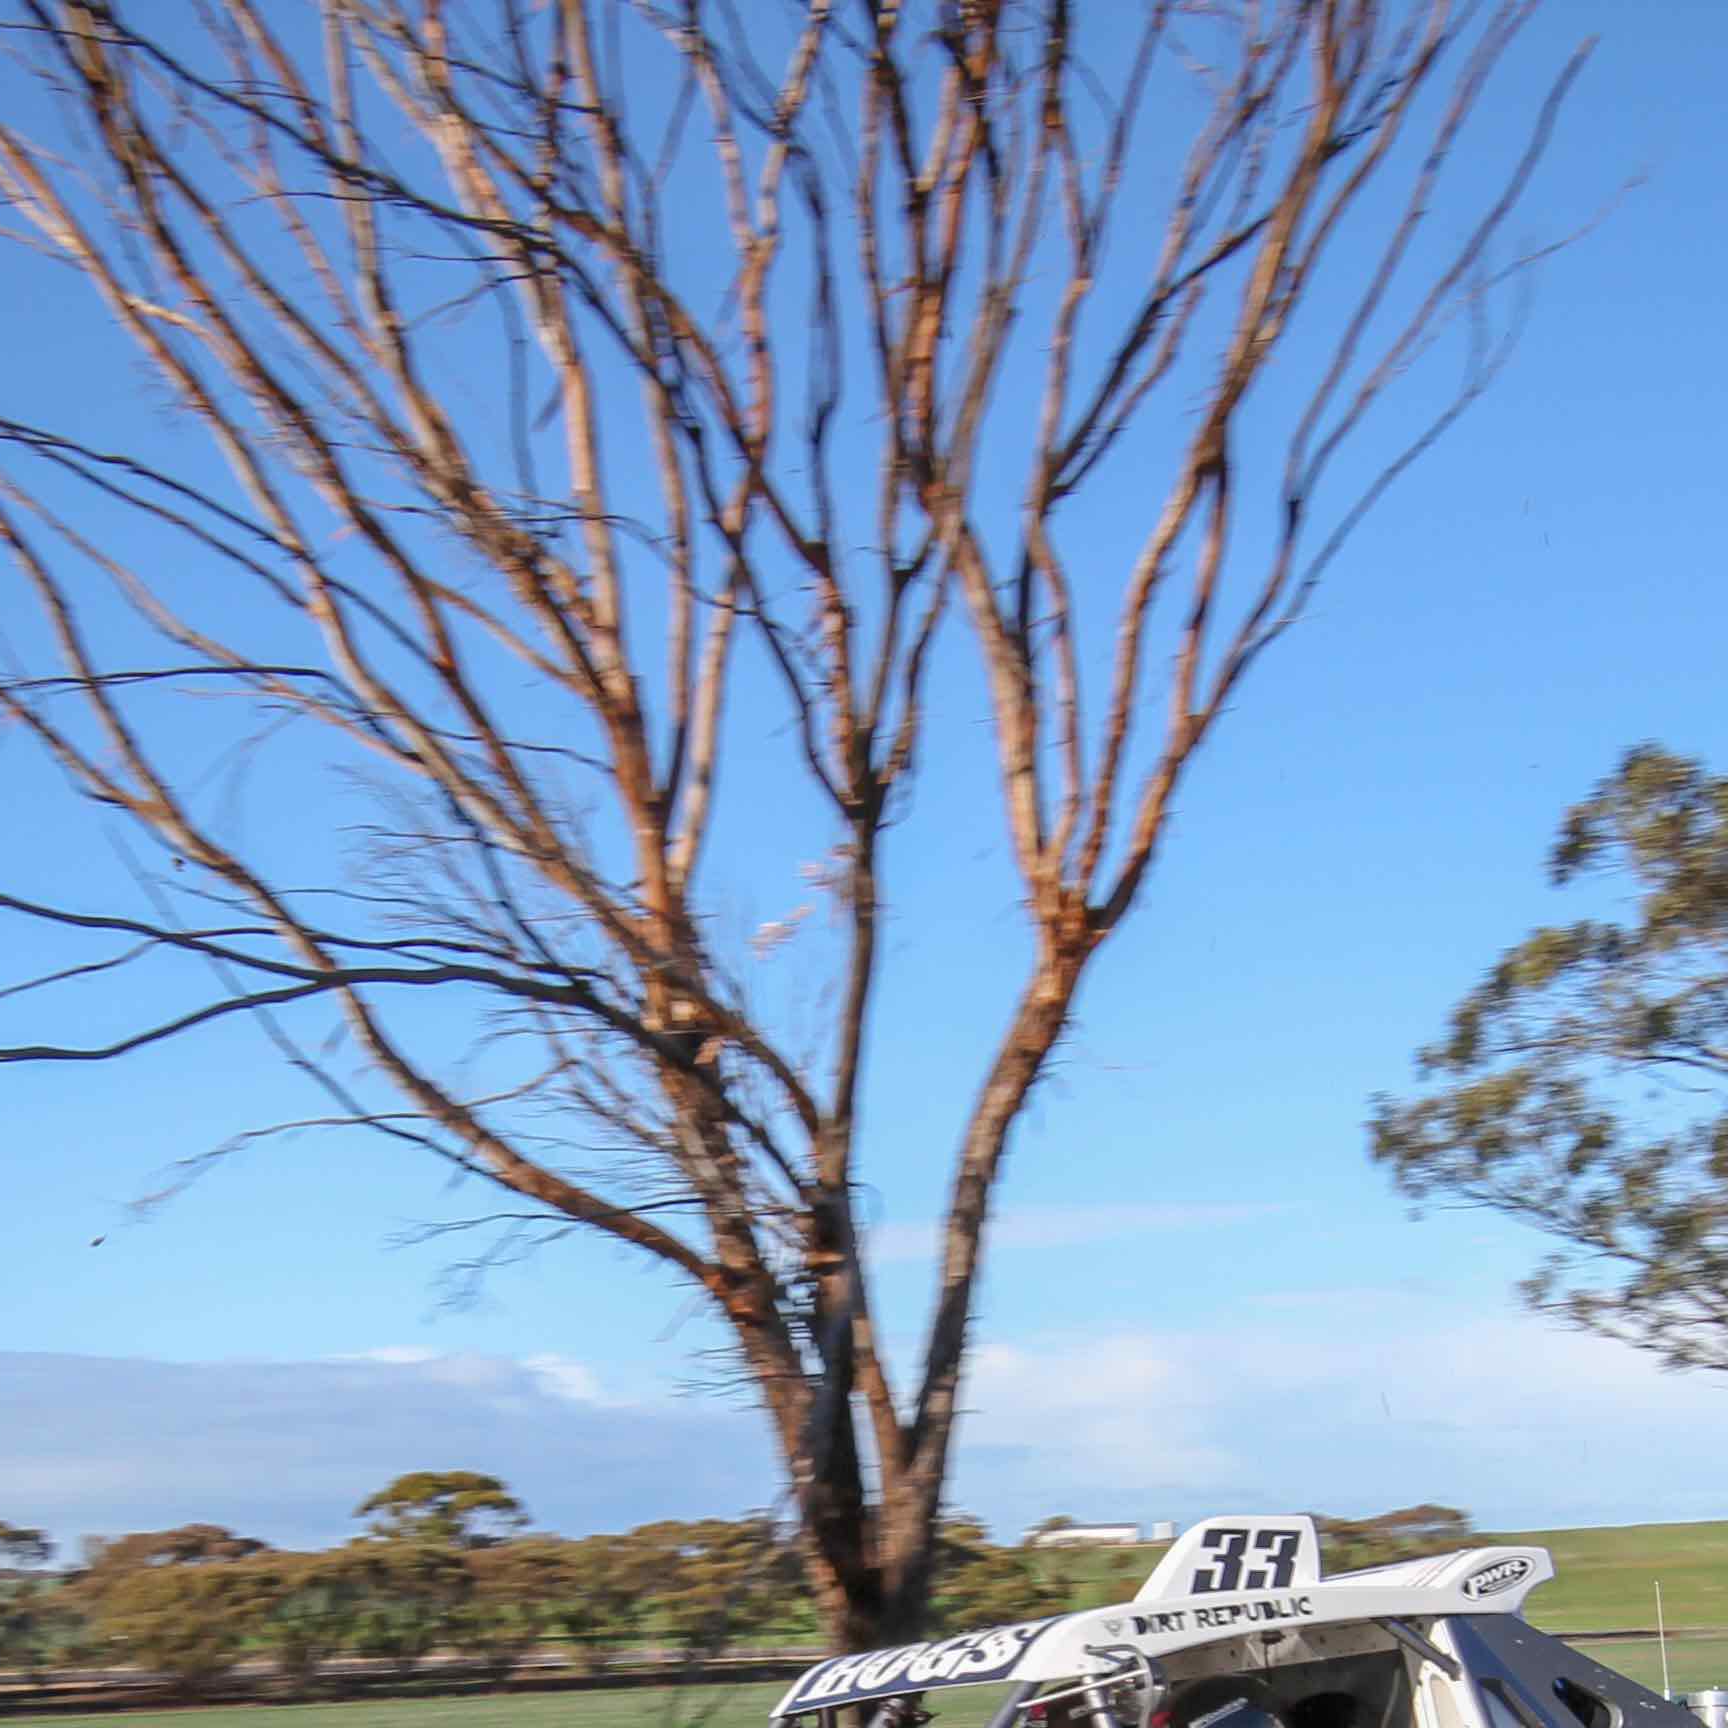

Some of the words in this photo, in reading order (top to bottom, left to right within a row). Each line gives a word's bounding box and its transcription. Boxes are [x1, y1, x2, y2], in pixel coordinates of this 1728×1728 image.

[1190, 1528, 1302, 1594] 33
[1465, 1560, 1528, 1600] PWR
[1130, 1609, 1187, 1636] DIRT
[1192, 1595, 1314, 1629] REPUBLIC
